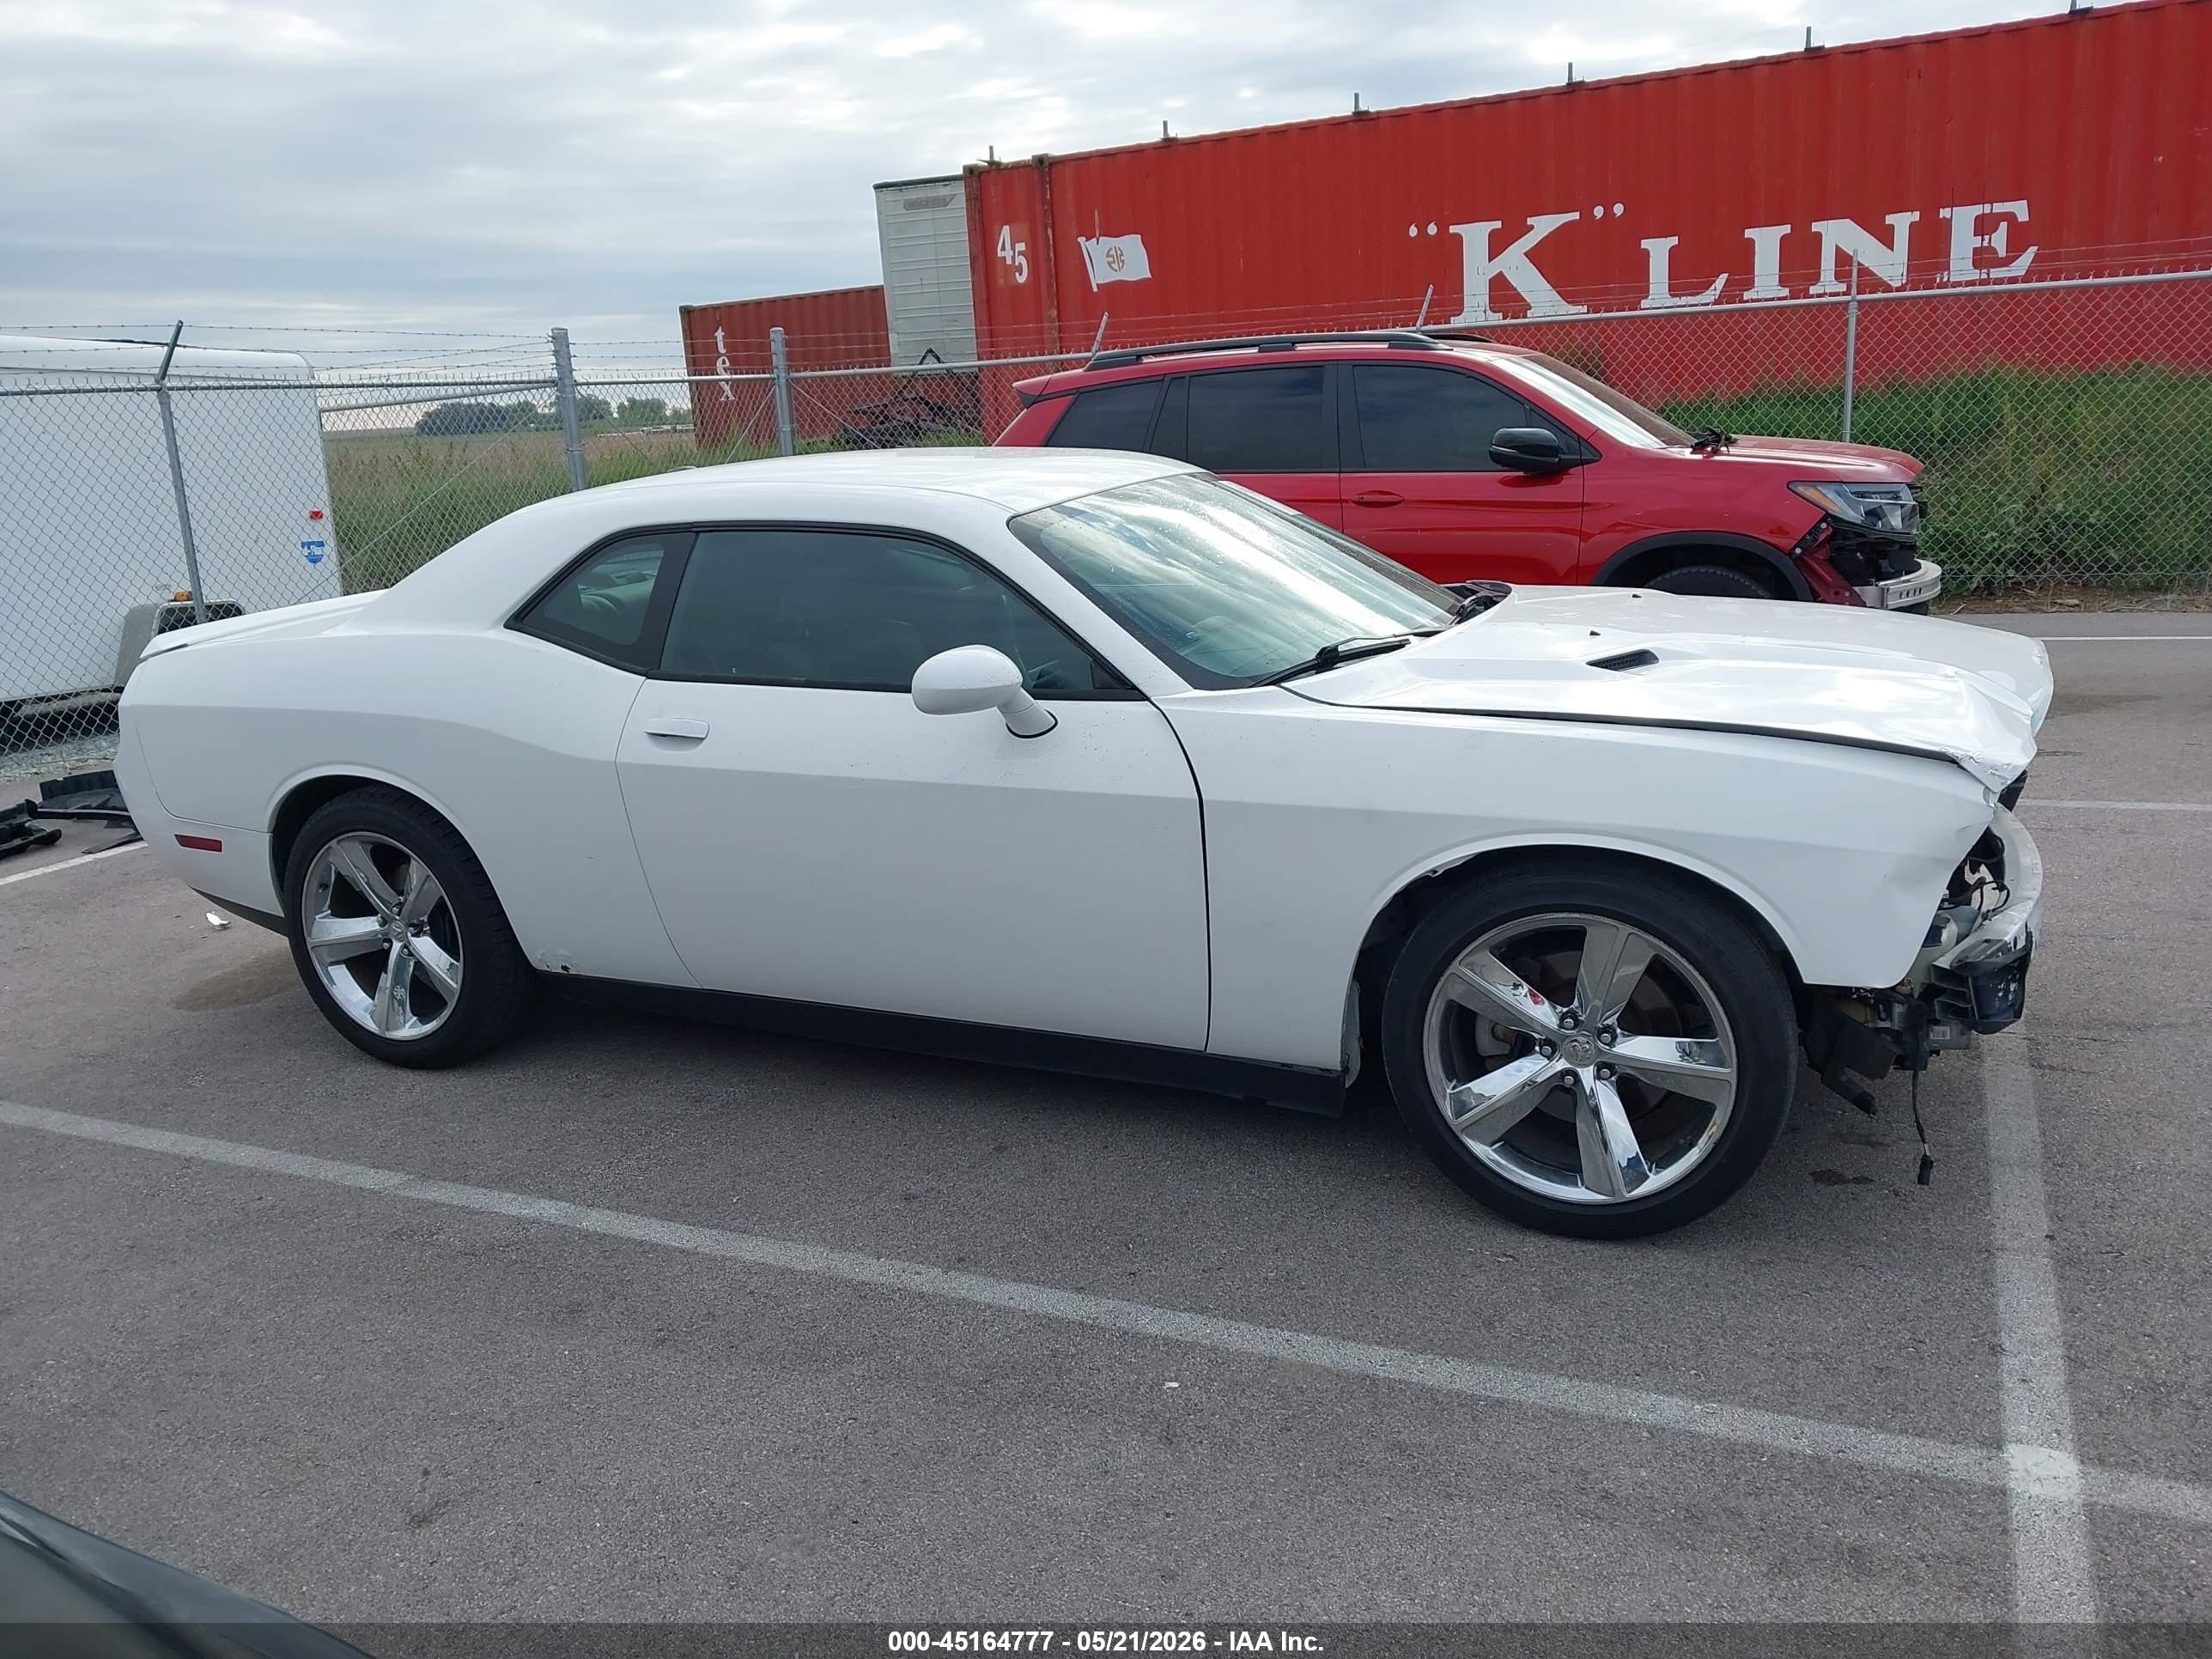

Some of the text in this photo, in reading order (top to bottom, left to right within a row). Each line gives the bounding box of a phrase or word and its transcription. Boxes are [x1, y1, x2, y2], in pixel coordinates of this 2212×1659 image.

[997, 224, 1029, 283] 45
[1640, 199, 2039, 309] LINE
[714, 325, 736, 401] tex
